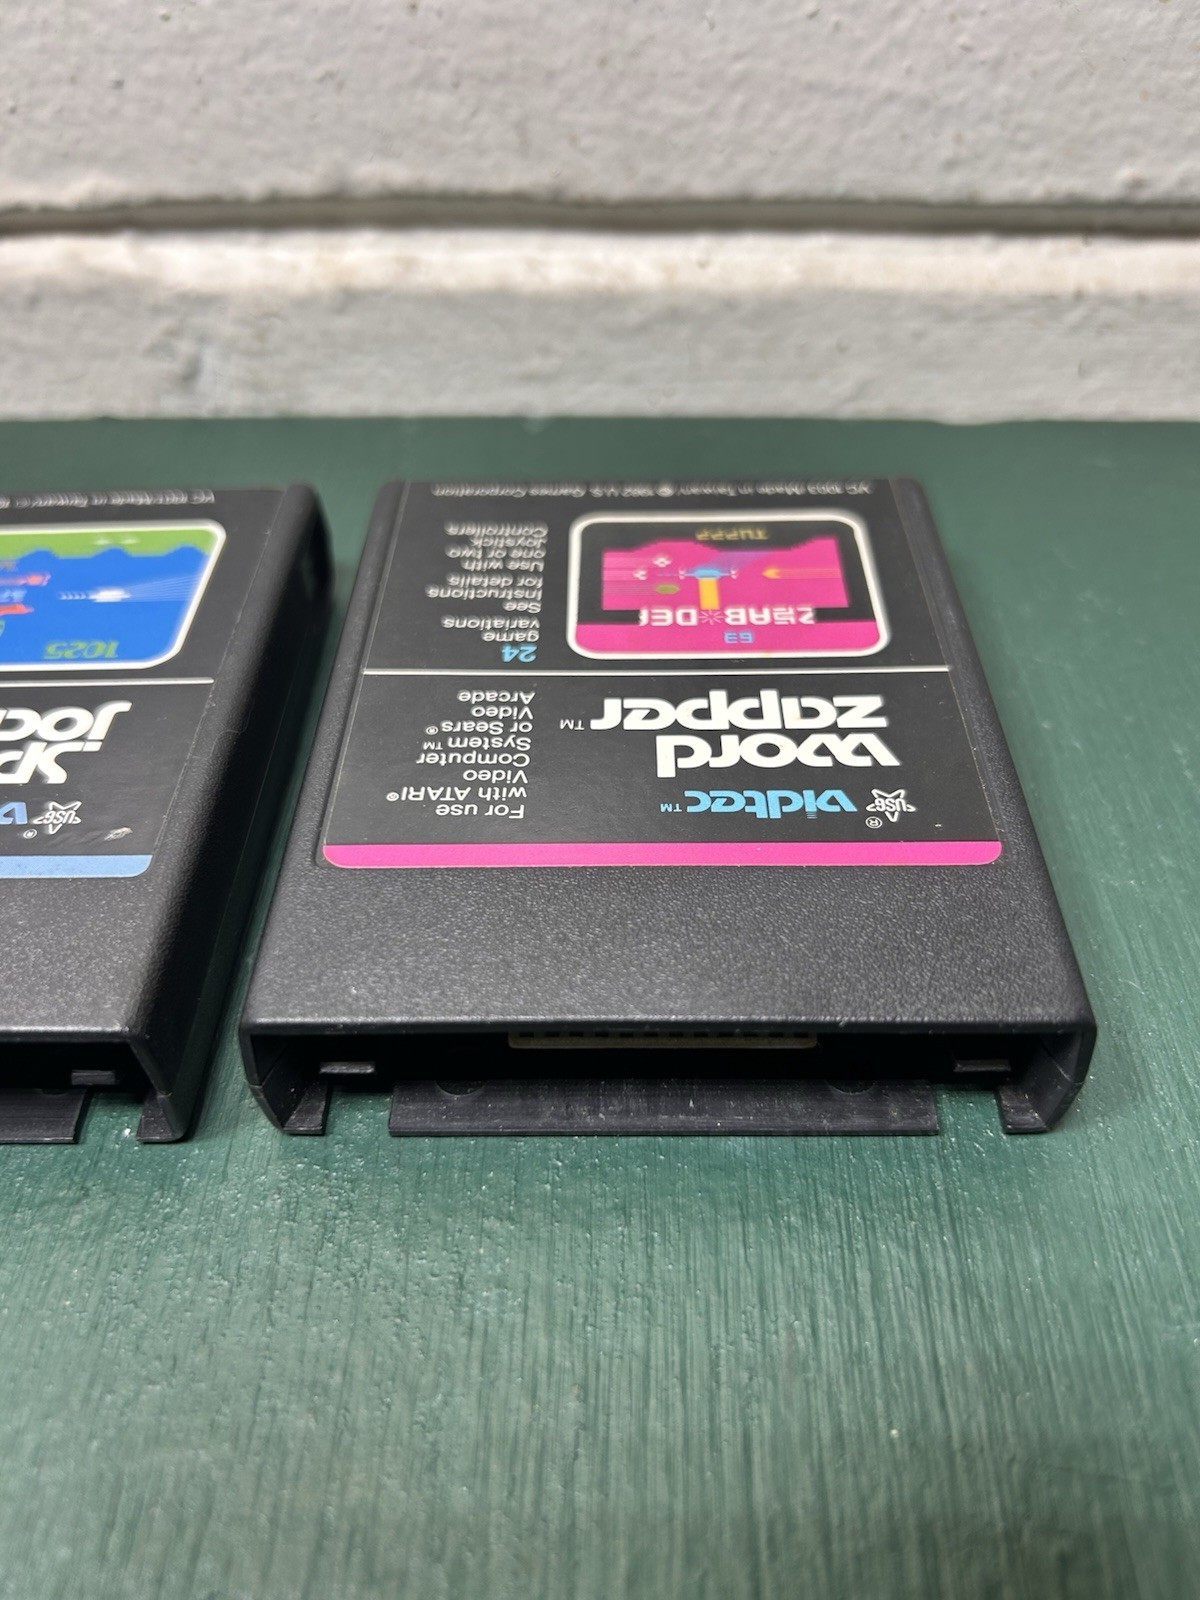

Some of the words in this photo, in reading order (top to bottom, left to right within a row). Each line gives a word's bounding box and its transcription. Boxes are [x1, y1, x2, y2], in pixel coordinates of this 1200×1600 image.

[443, 521, 549, 538] Controllers
[468, 535, 548, 548] Joystick
[444, 543, 483, 560] two
[486, 546, 507, 559] or
[508, 545, 547, 559] one
[460, 558, 504, 571] with
[505, 559, 545, 572] Use
[445, 572, 513, 588] details
[516, 574, 544, 588] for
[424, 584, 543, 600] Instructions
[502, 600, 541, 614] See
[441, 615, 540, 631] variations
[481, 629, 540, 642] game
[724, 630, 753, 644] 63
[43, 640, 118, 660] 1025
[501, 643, 537, 663] 24
[457, 690, 536, 705] Arcade
[471, 706, 534, 720] Video
[590, 688, 888, 731] zapper
[510, 721, 533, 733] or
[416, 750, 531, 767] Computer
[656, 733, 901, 778] word
[463, 770, 528, 784] Video
[478, 786, 527, 801] with
[435, 804, 479, 816] use
[485, 804, 525, 819] For
[684, 789, 858, 819] vidtec
